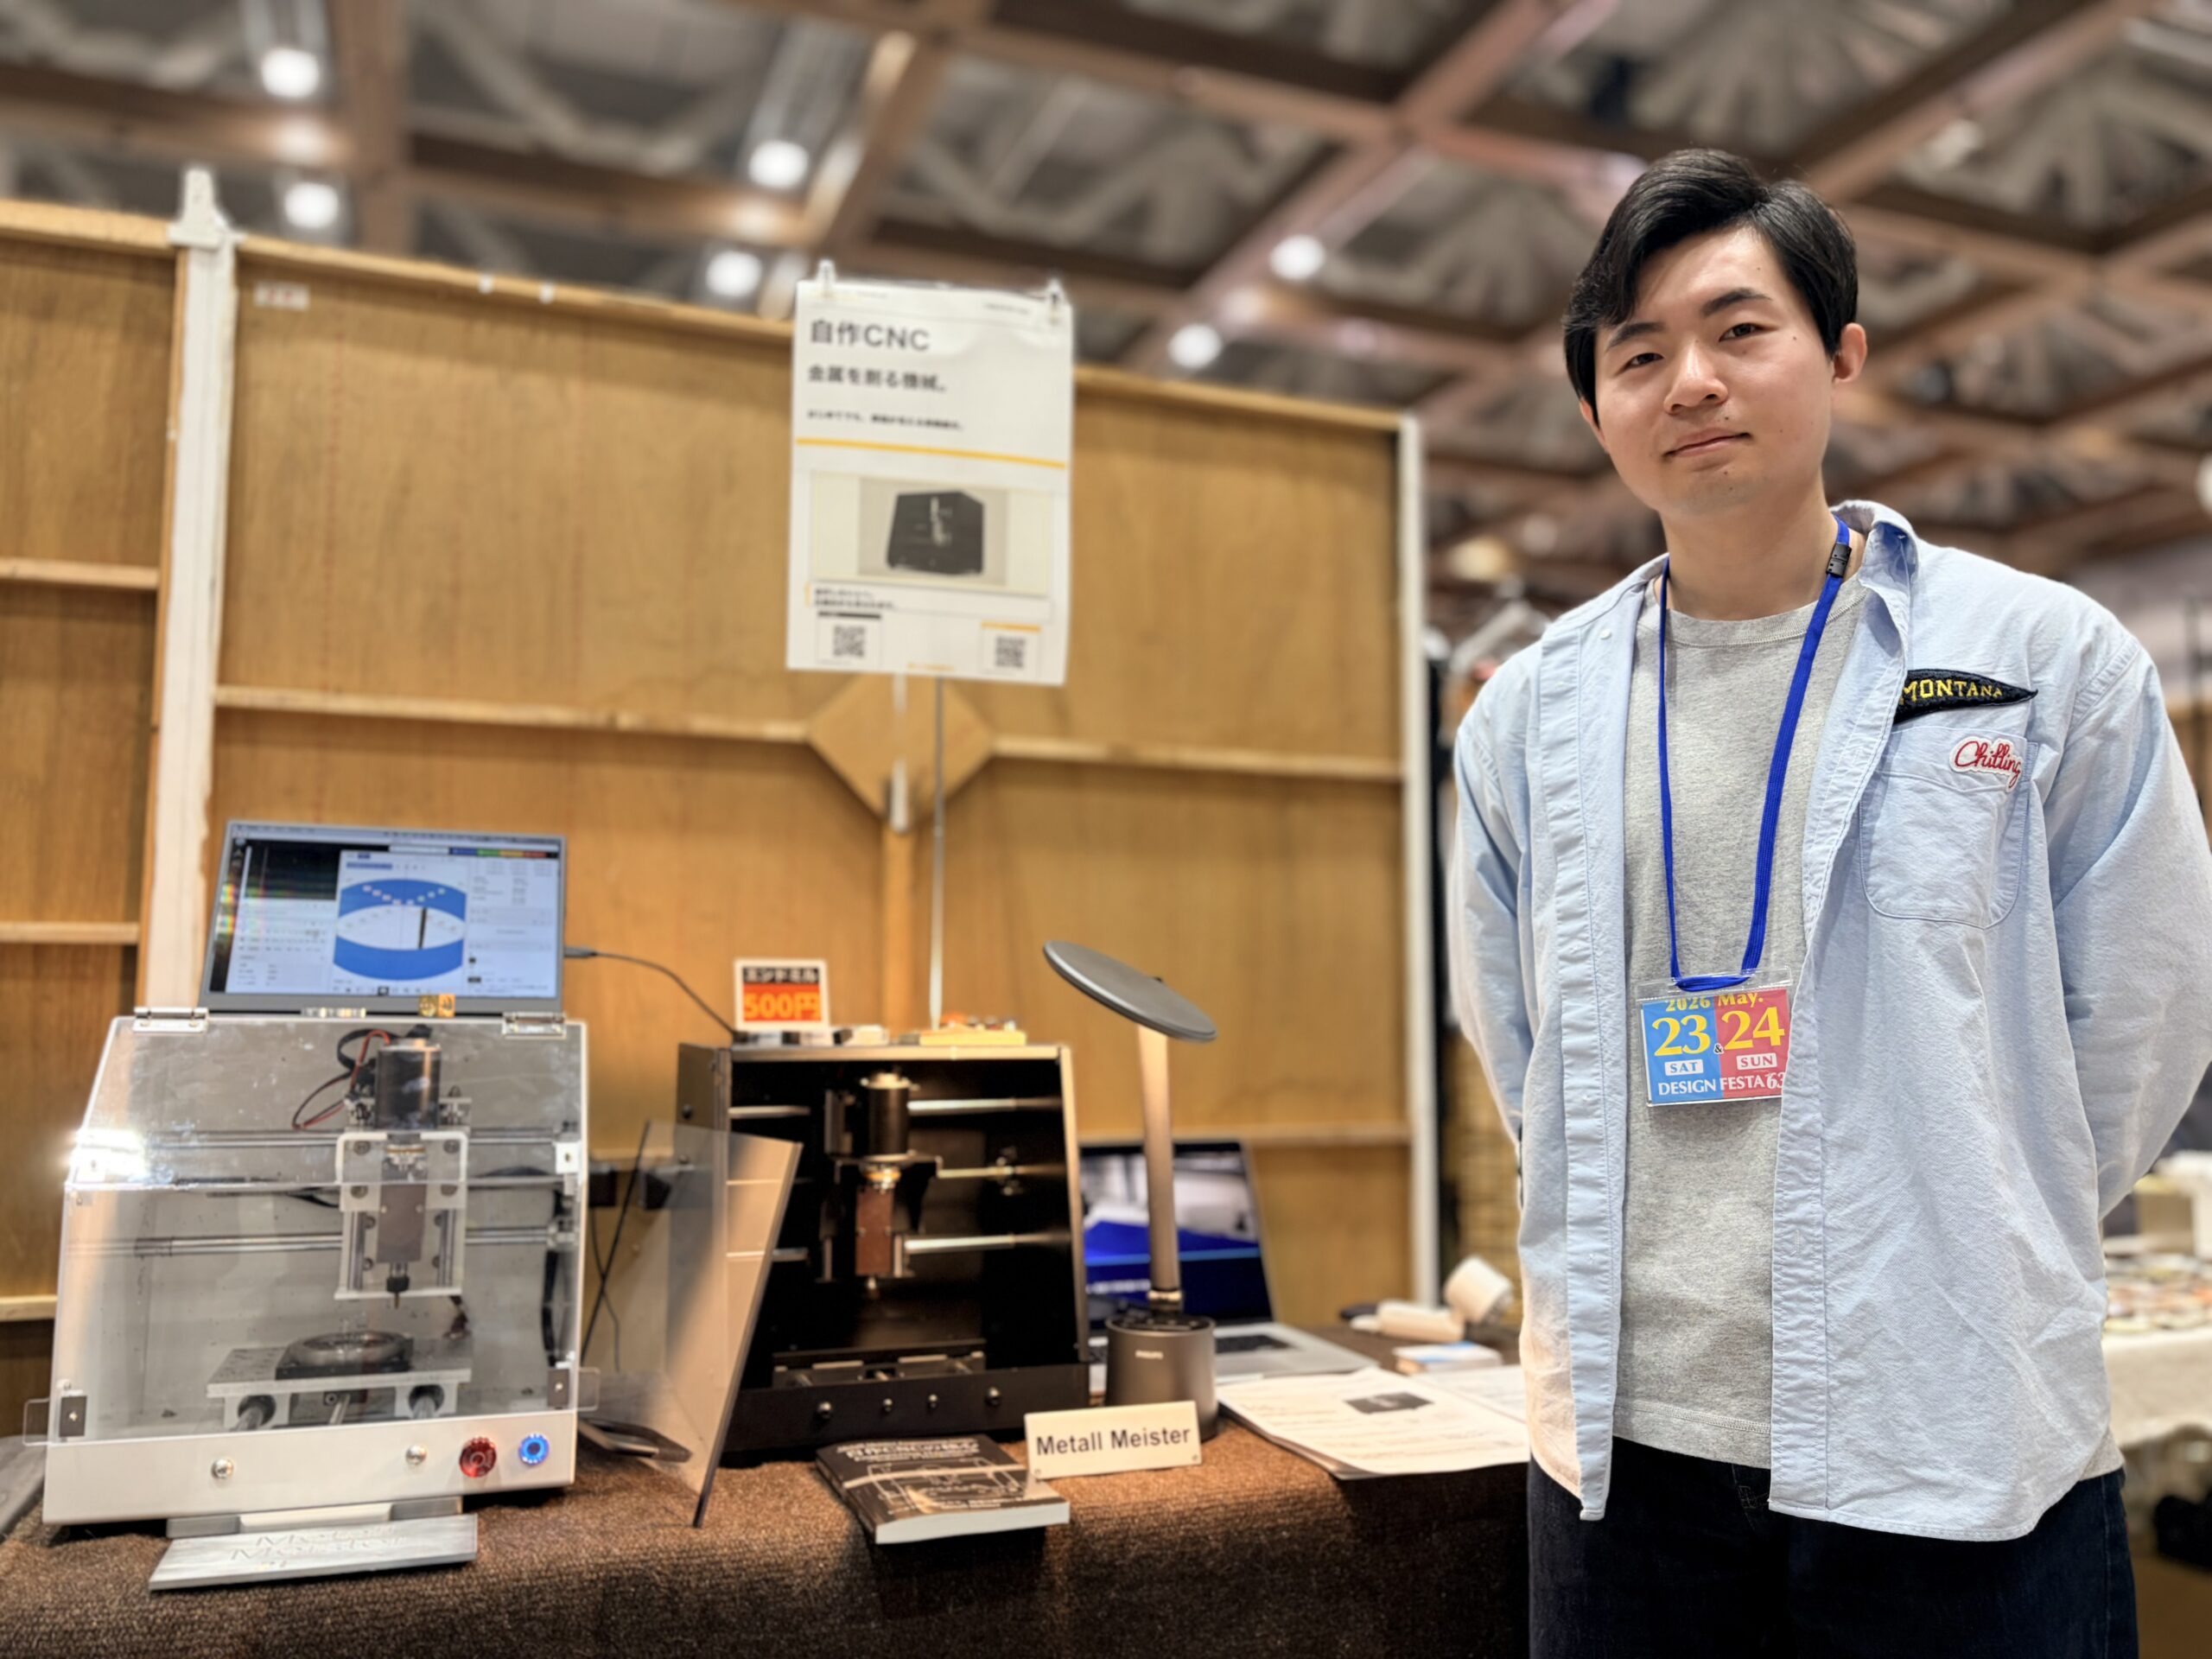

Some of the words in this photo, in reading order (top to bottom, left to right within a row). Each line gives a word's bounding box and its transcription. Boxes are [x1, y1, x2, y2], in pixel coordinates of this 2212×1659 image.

[810, 319, 931, 352] 自作CNC
[1899, 678, 2002, 705] MONTANA
[1955, 741, 2022, 789] Chilling
[744, 991, 820, 1020] 500円
[1665, 996, 1711, 1013] 2026
[1718, 992, 1764, 1008] May.
[1651, 1014, 1711, 1056] 23
[1721, 1007, 1785, 1050] 24
[1669, 1061, 1699, 1073] SAT
[1740, 1055, 1773, 1068] SUN
[1657, 1078, 1717, 1096] DESIGN
[1719, 1075, 1765, 1090] FESTA
[1036, 1431, 1103, 1456] Metall
[1110, 1427, 1191, 1450] Meister
